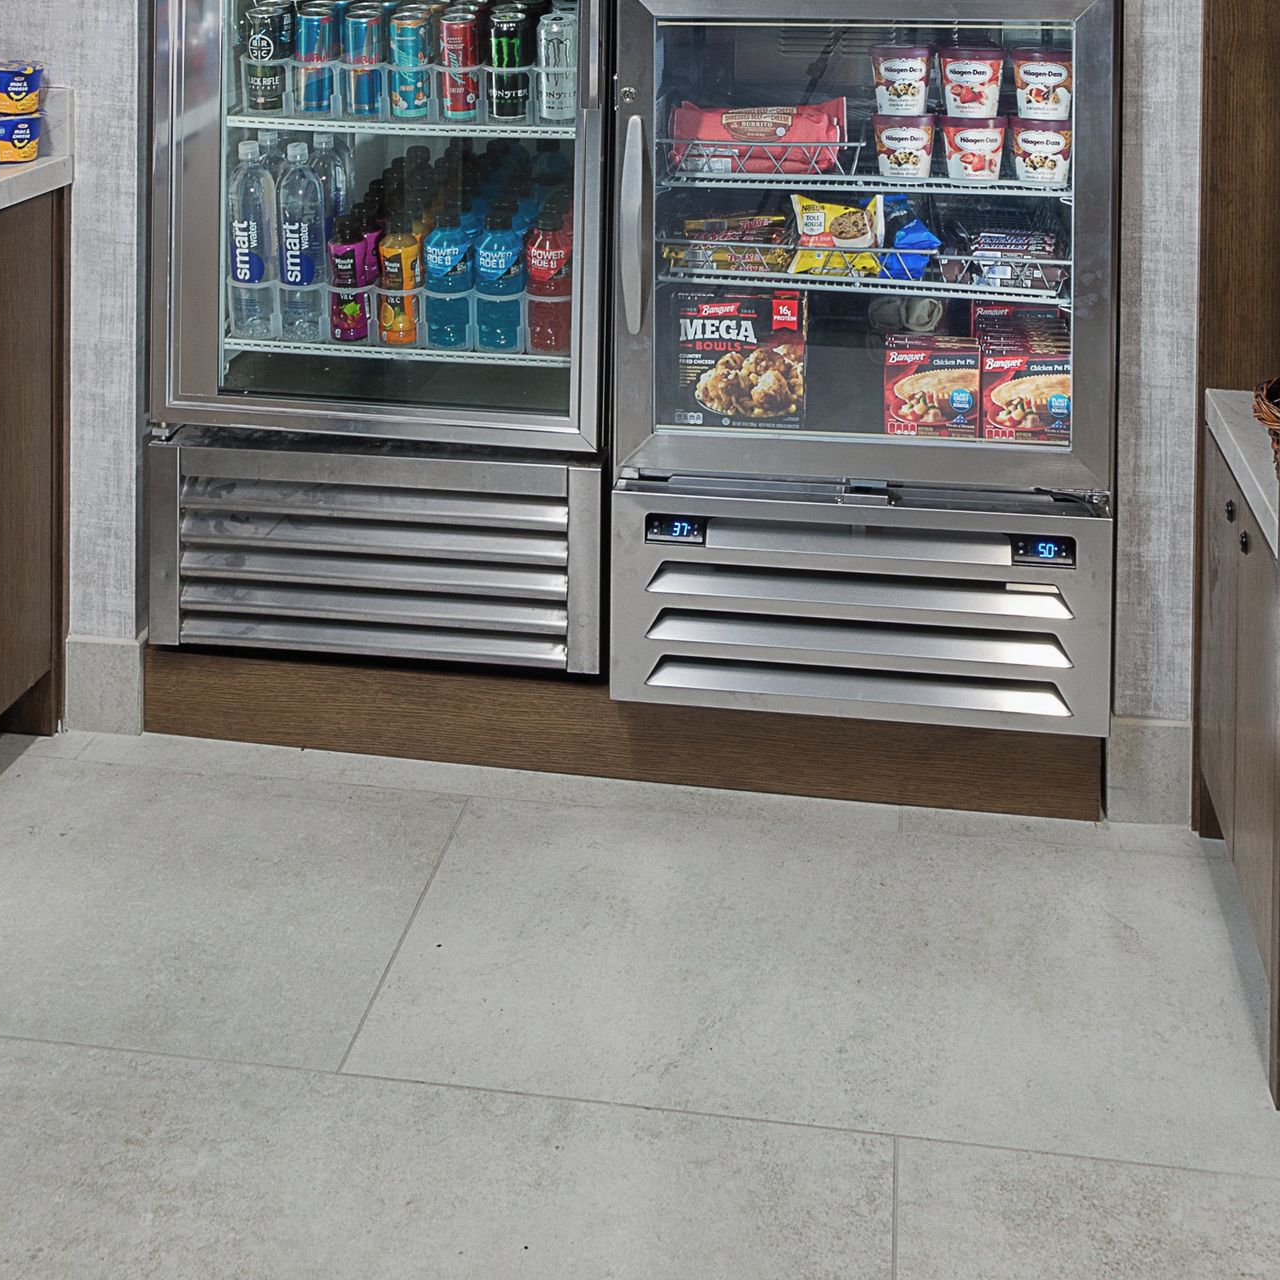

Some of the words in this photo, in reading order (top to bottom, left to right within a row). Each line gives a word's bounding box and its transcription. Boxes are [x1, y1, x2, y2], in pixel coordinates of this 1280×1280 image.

[248, 220, 258, 248] water
[300, 222, 309, 250] water
[232, 220, 251, 281] smart
[282, 222, 302, 283] smart
[701, 303, 737, 315] Banquet
[679, 318, 758, 344] MEGA
[695, 341, 742, 352] BOWLS
[888, 351, 927, 364] Banquet
[932, 358, 955, 366] Chicken
[955, 358, 966, 366] Pot
[985, 357, 1024, 370] Banquet
[1030, 364, 1053, 372] Chicken
